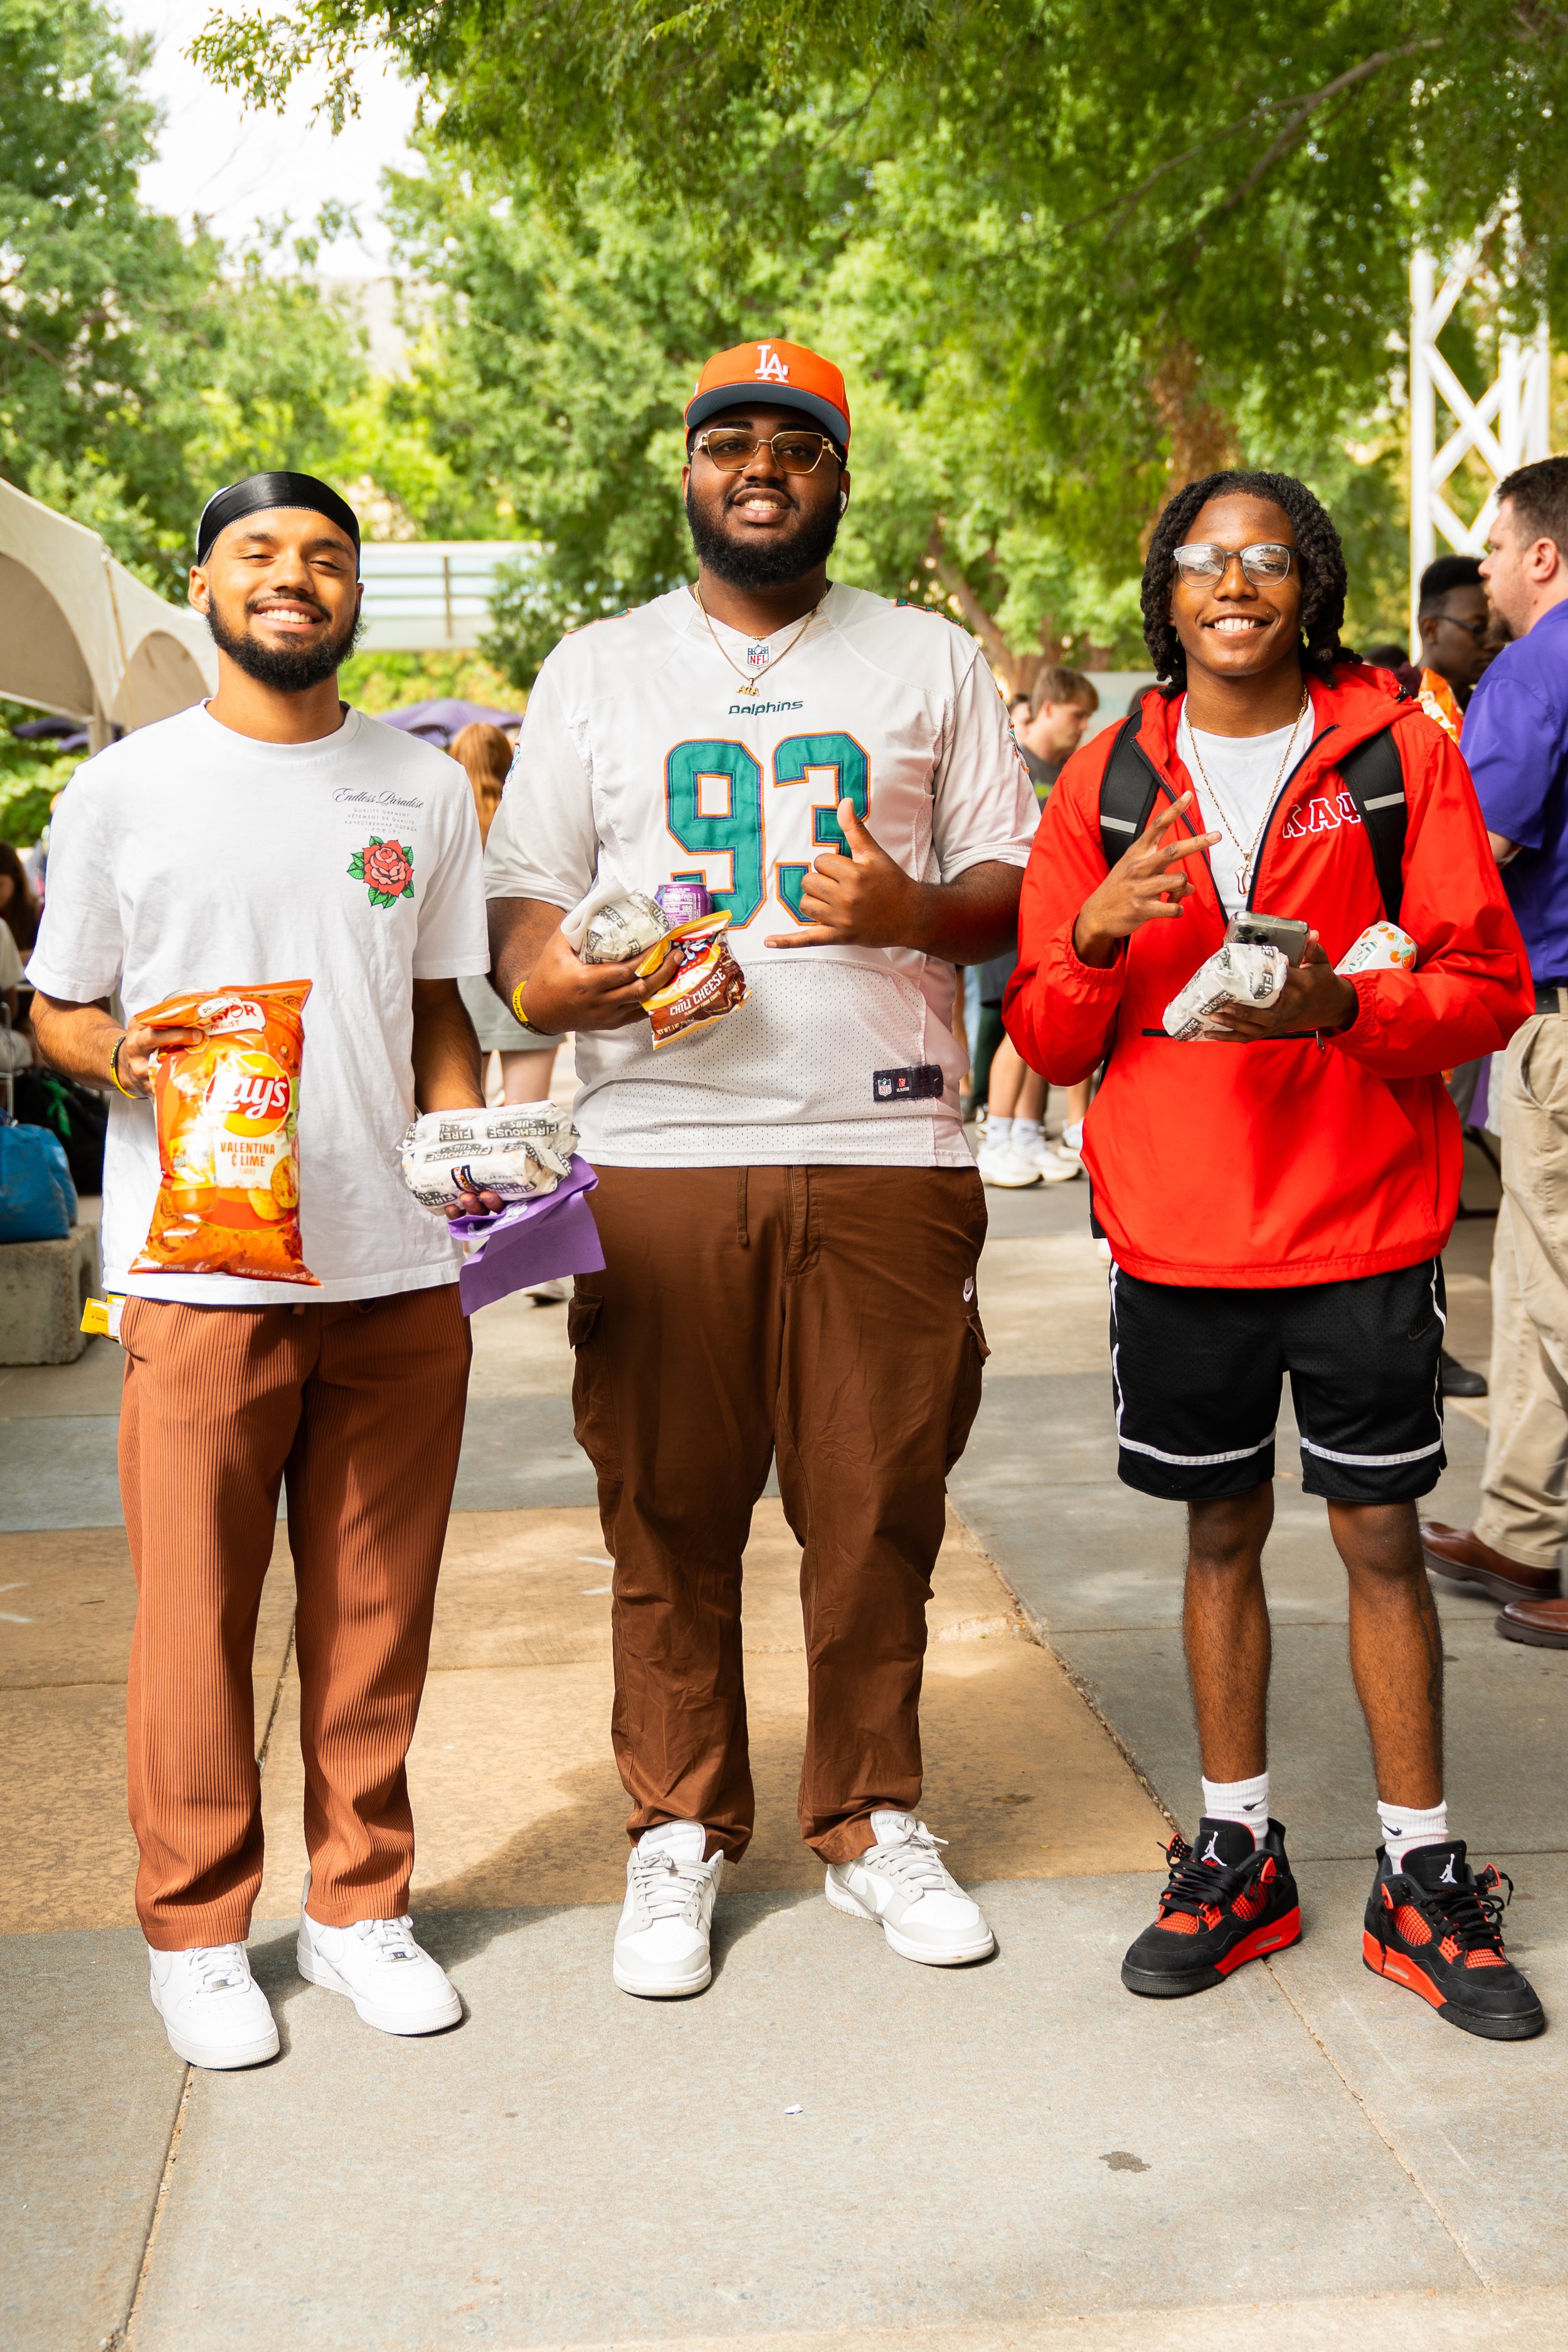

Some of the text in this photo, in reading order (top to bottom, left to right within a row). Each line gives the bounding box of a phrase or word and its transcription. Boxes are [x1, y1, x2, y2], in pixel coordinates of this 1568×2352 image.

[755, 344, 789, 383] LA
[750, 654, 767, 665] NFL
[728, 701, 803, 716] Dolphins
[332, 788, 424, 808] Endless Paradise
[664, 730, 871, 930] 93
[669, 968, 726, 1016] CHILI CHEESE
[1200, 990, 1235, 1015] FIREHOUSE
[210, 1071, 288, 1120] Lay's
[488, 1121, 559, 1139] FIREHOUSE
[509, 1118, 536, 1129] SUBS
[220, 1142, 275, 1155] VALENTINA
[426, 1145, 492, 1162] FIREHOUSE
[241, 1156, 265, 1167] LIME
